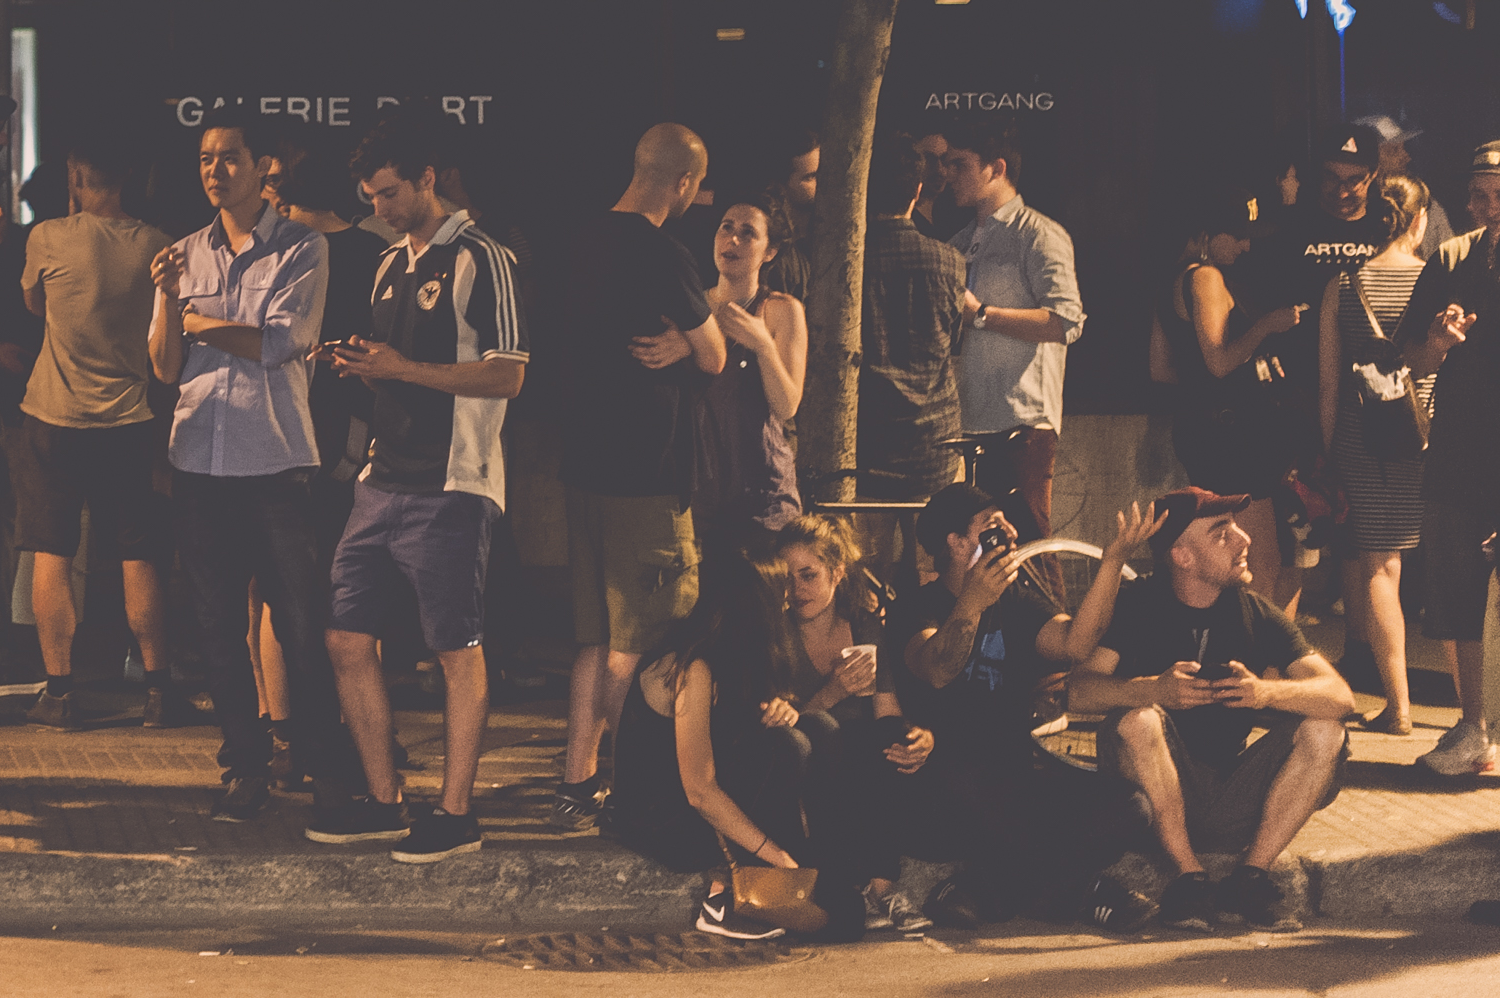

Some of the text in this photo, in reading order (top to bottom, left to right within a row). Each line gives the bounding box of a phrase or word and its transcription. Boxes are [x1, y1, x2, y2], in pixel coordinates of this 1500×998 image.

[924, 92, 1055, 111] ARTGANG
[176, 95, 351, 128] GERIE
[1303, 242, 1379, 257] ARTGAN
